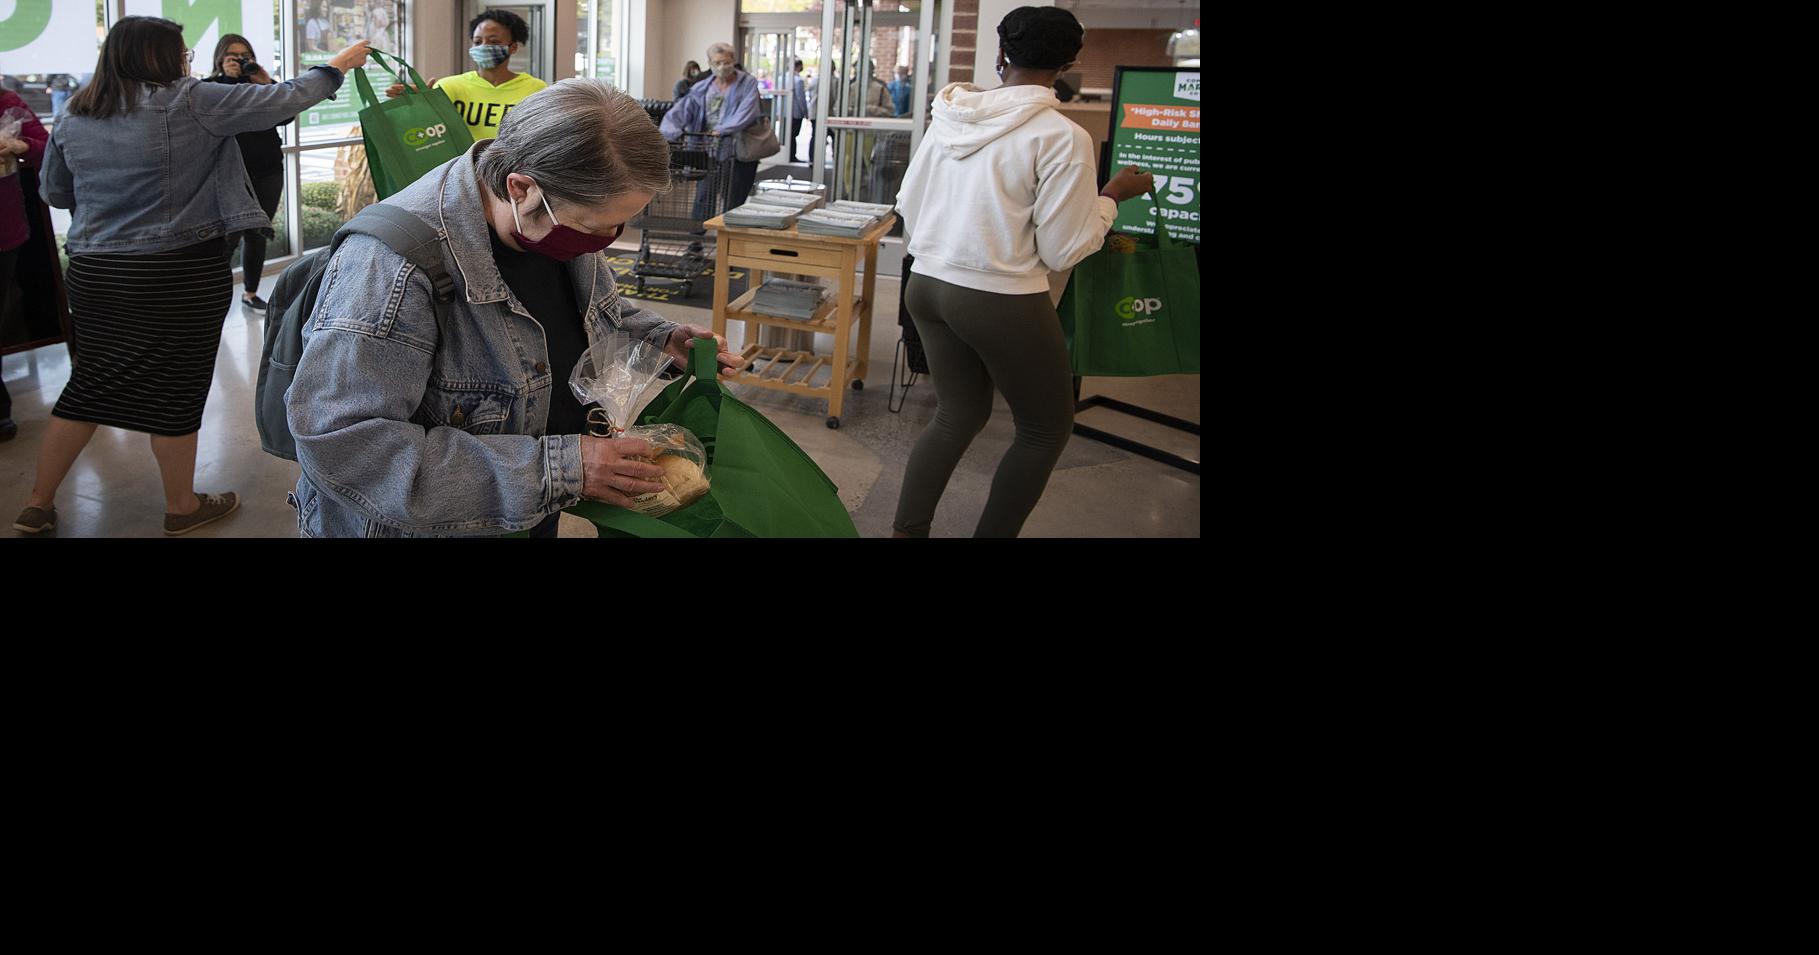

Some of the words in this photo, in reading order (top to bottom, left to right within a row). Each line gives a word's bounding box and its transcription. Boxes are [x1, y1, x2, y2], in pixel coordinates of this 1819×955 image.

[1152, 118, 1179, 128] Daily
[1134, 133, 1163, 141] Hours
[1142, 154, 1172, 162] interest
[1141, 174, 1200, 205] 75
